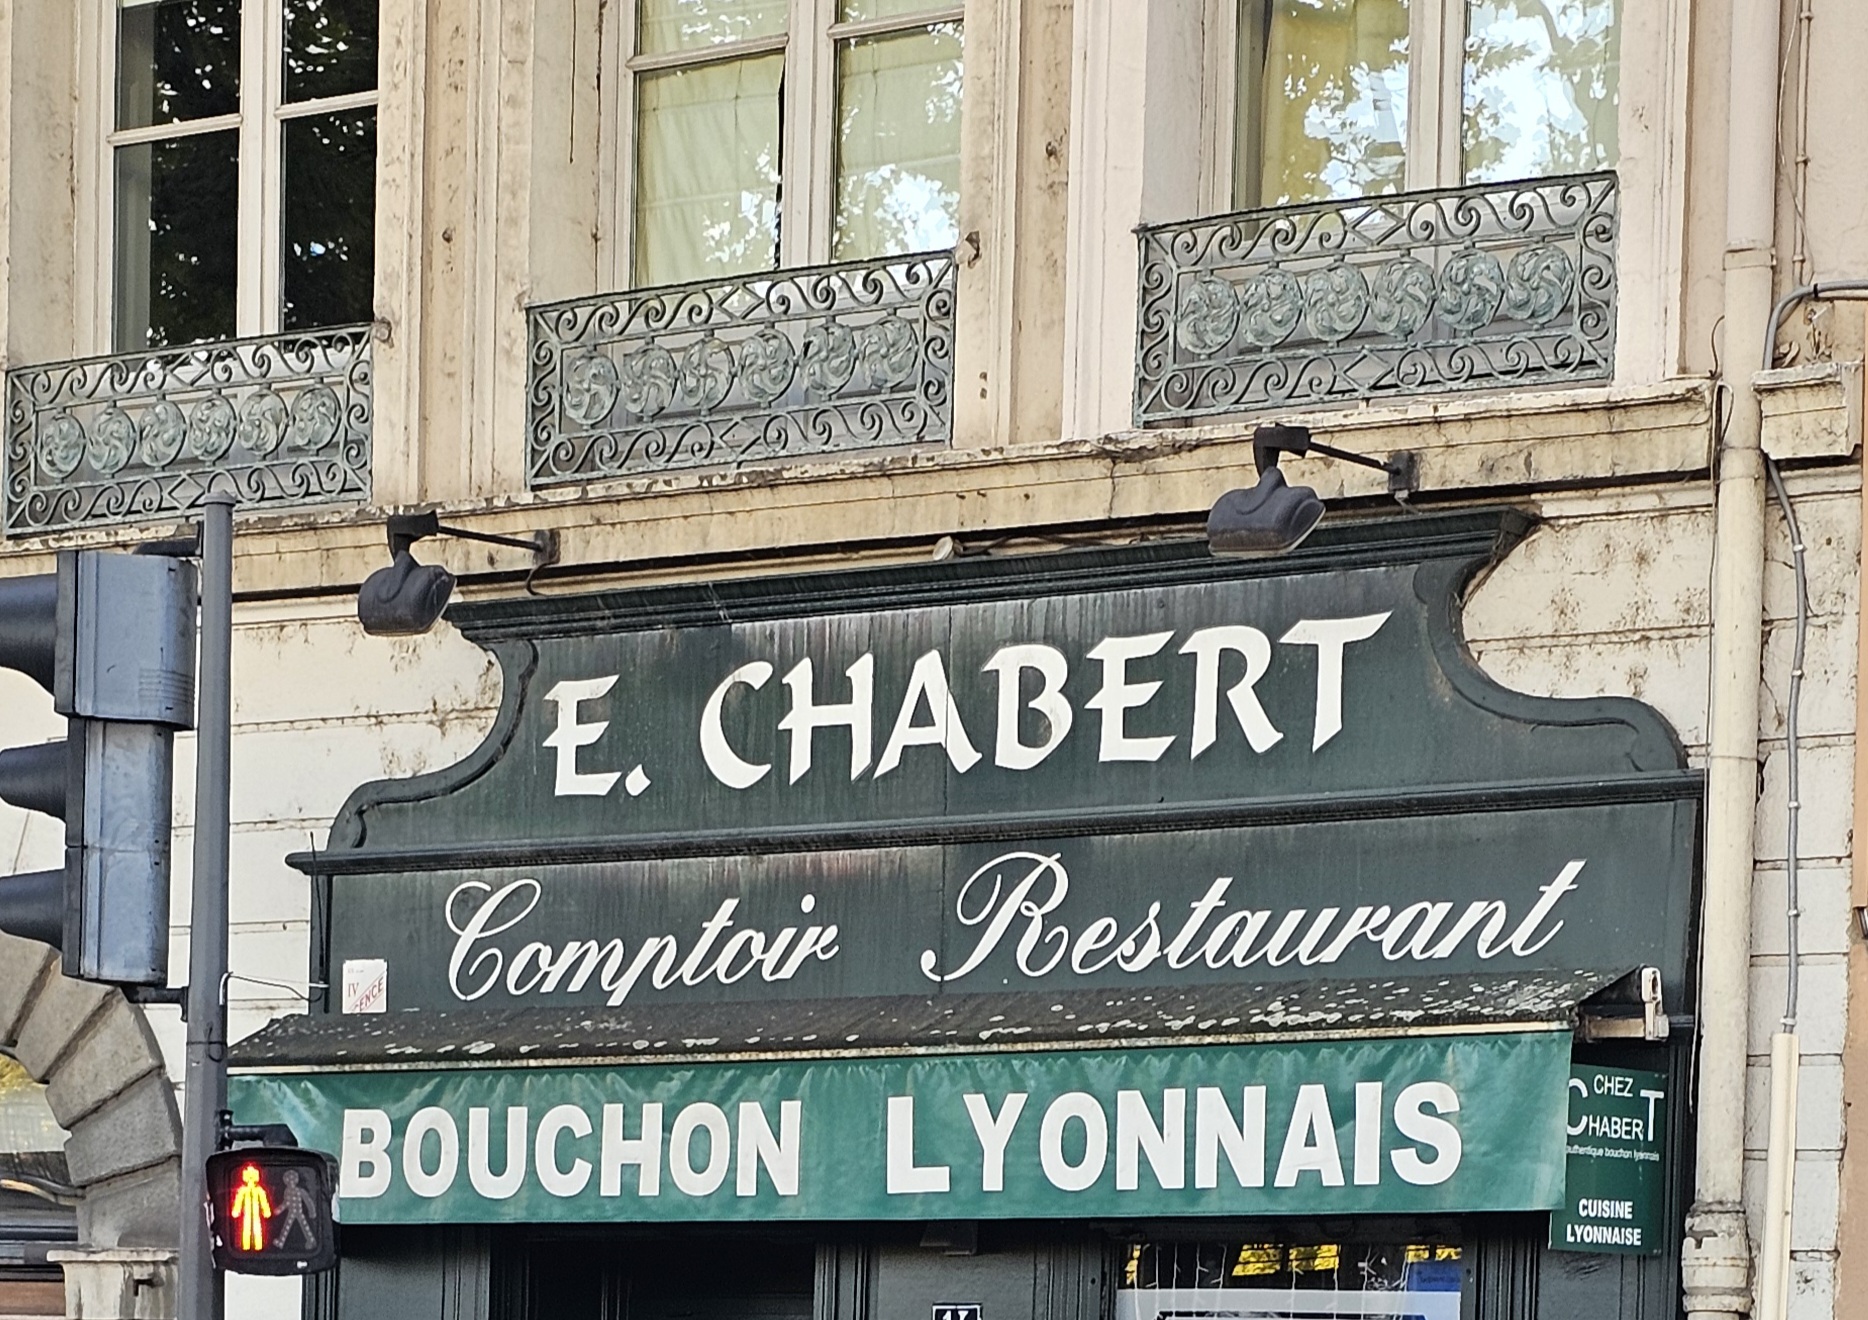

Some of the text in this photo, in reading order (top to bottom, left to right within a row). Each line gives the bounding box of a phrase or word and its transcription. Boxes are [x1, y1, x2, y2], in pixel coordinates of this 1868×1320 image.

[542, 609, 1394, 798] E. CHABERT
[444, 850, 1588, 1008] Comptoir Restaurant
[1593, 1073, 1634, 1098] CHEZ
[338, 1080, 1463, 1200] BOUCHON LYONNAIS
[1604, 1147, 1633, 1159] bouchon
[1578, 1197, 1634, 1220] CUISINE
[1566, 1223, 1642, 1246] LYONNAISE
